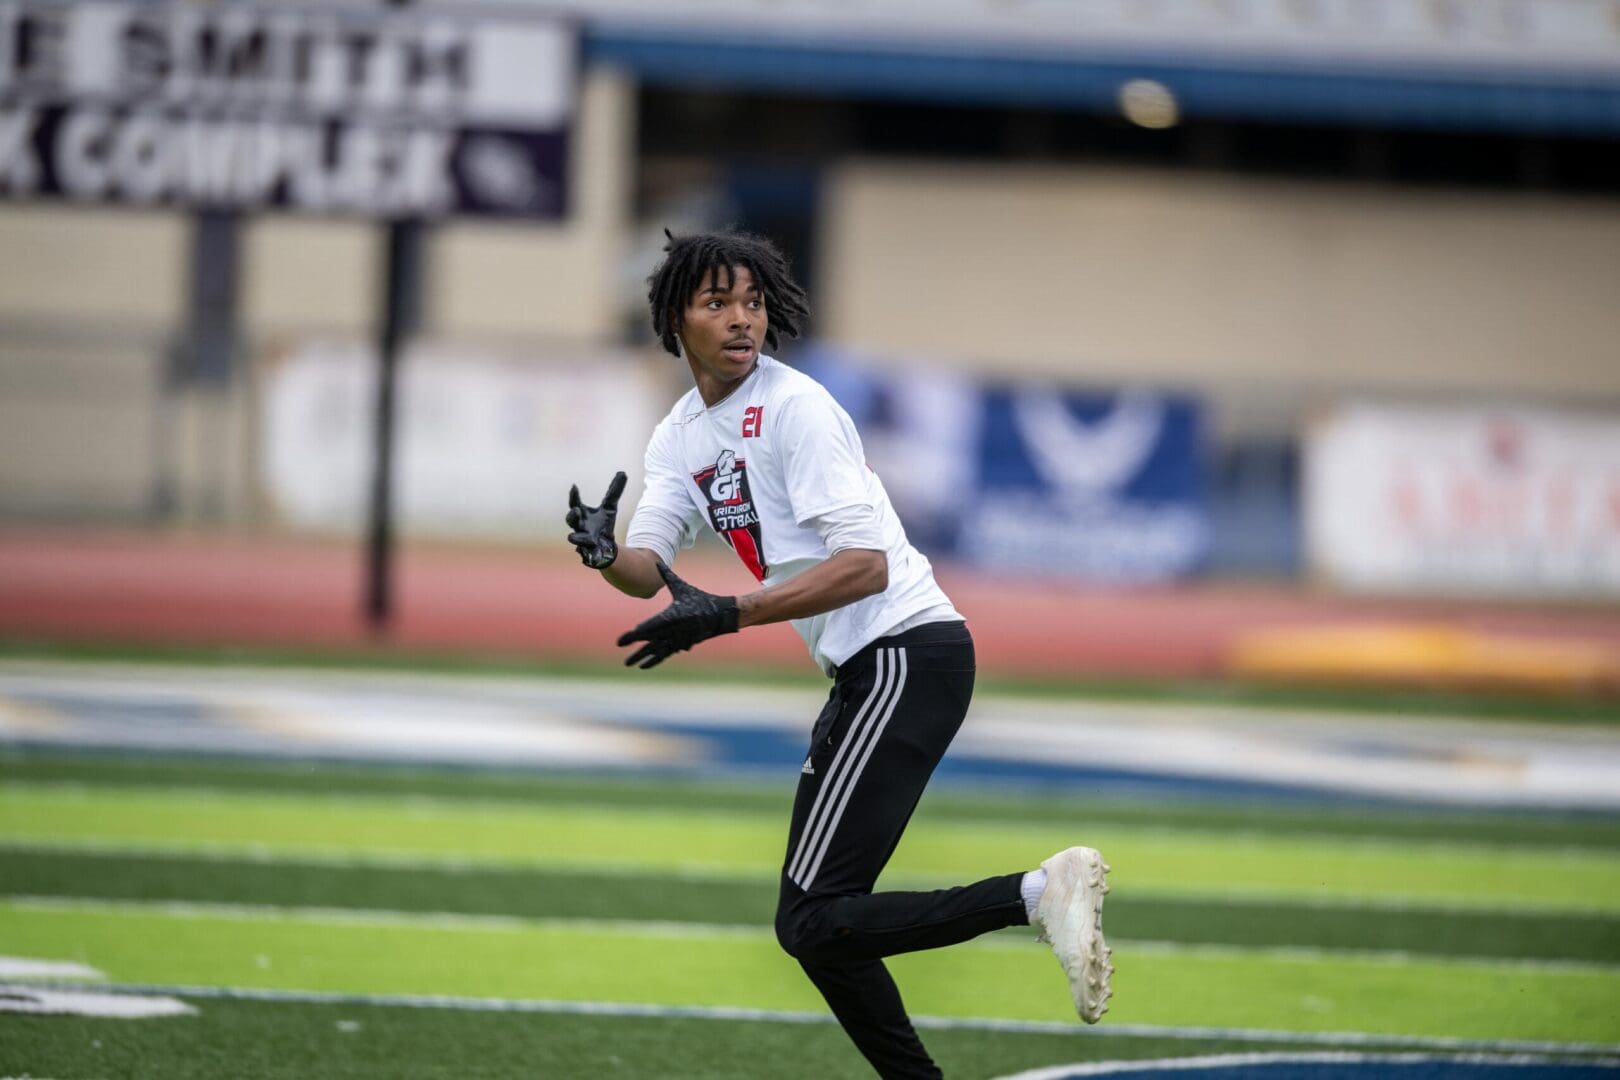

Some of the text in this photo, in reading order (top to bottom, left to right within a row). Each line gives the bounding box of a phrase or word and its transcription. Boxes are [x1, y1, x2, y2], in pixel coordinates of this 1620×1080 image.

[118, 18, 470, 89] SMITH
[56, 110, 455, 208] COMPLEX
[742, 406, 764, 438] 21
[710, 470, 742, 500] GF
